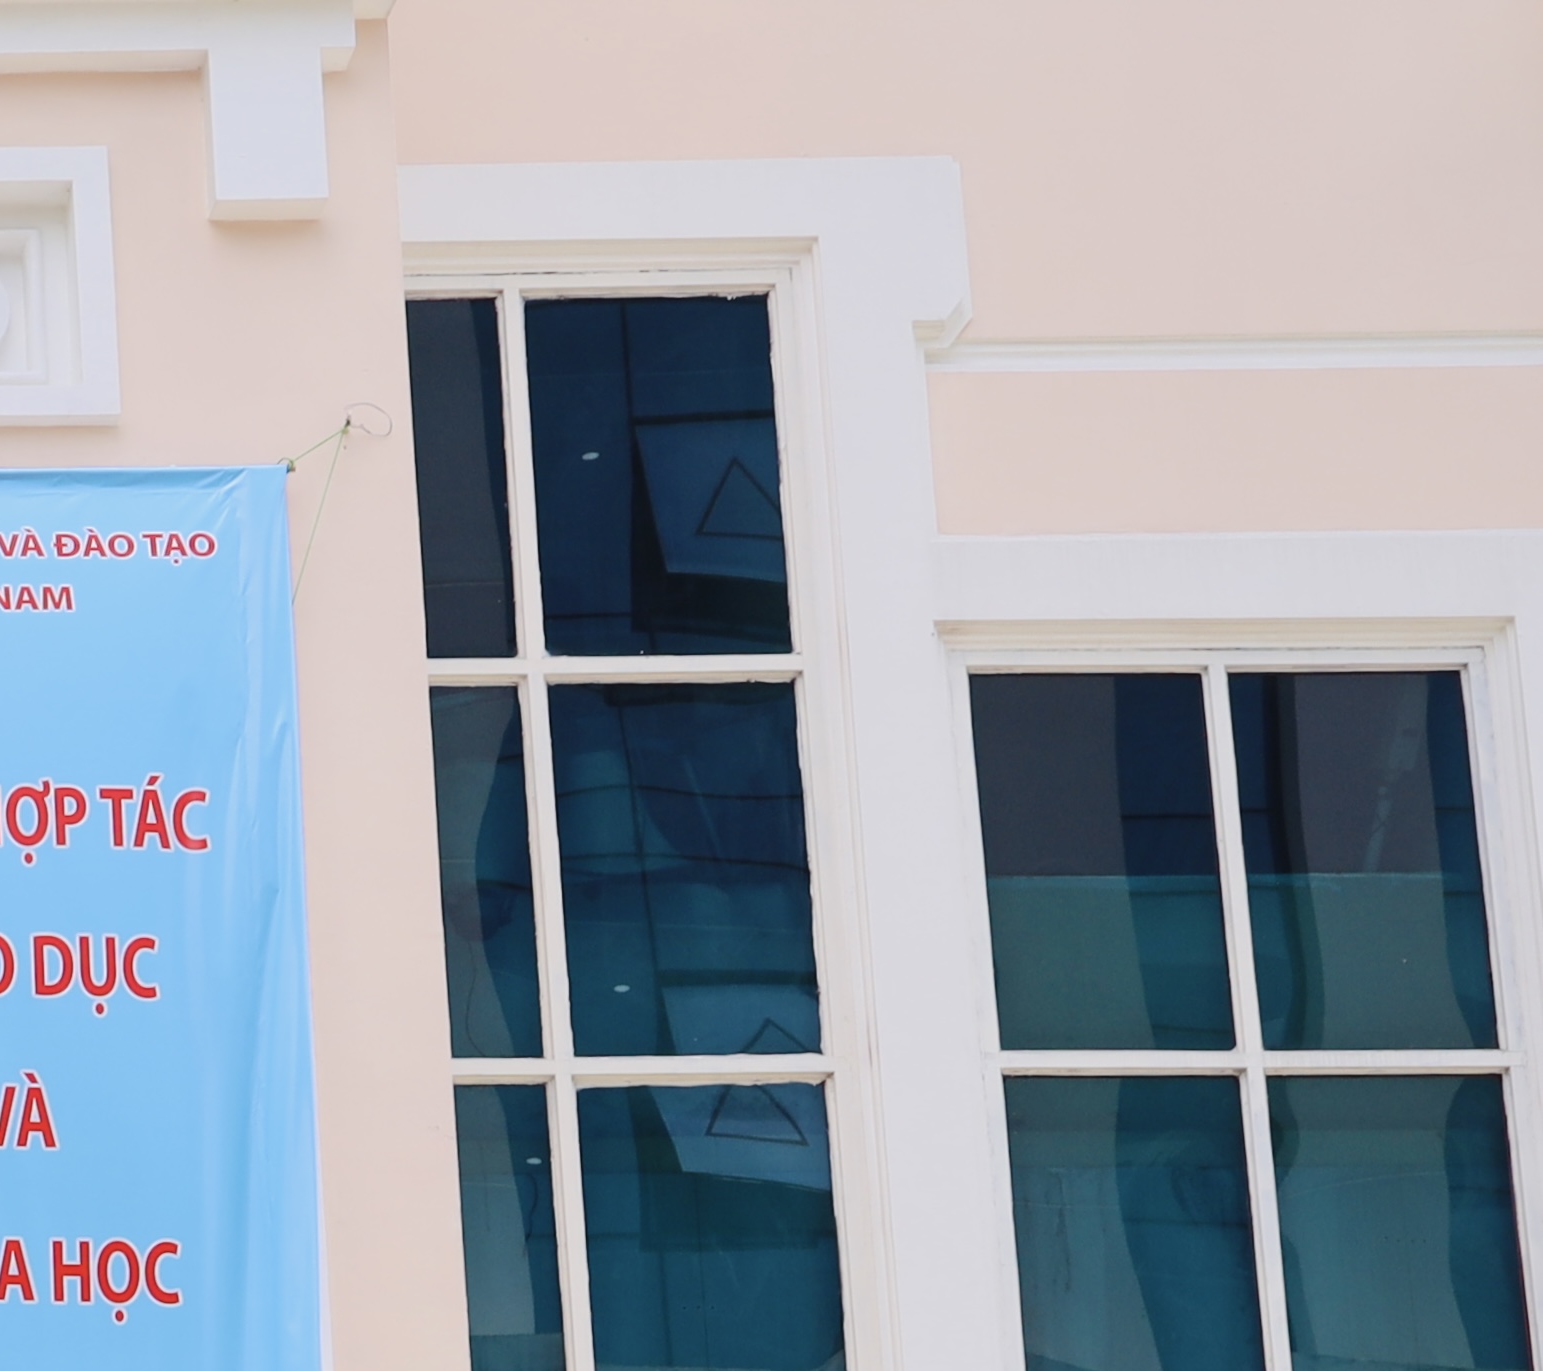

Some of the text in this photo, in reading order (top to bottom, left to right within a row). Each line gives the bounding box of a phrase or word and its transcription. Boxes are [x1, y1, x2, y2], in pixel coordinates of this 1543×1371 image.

[53, 530, 137, 559] ĐÀO
[142, 531, 218, 565] TẠO
[98, 773, 211, 852] TÁC
[32, 933, 159, 1016] DỤC
[51, 1238, 182, 1324] HỌC
